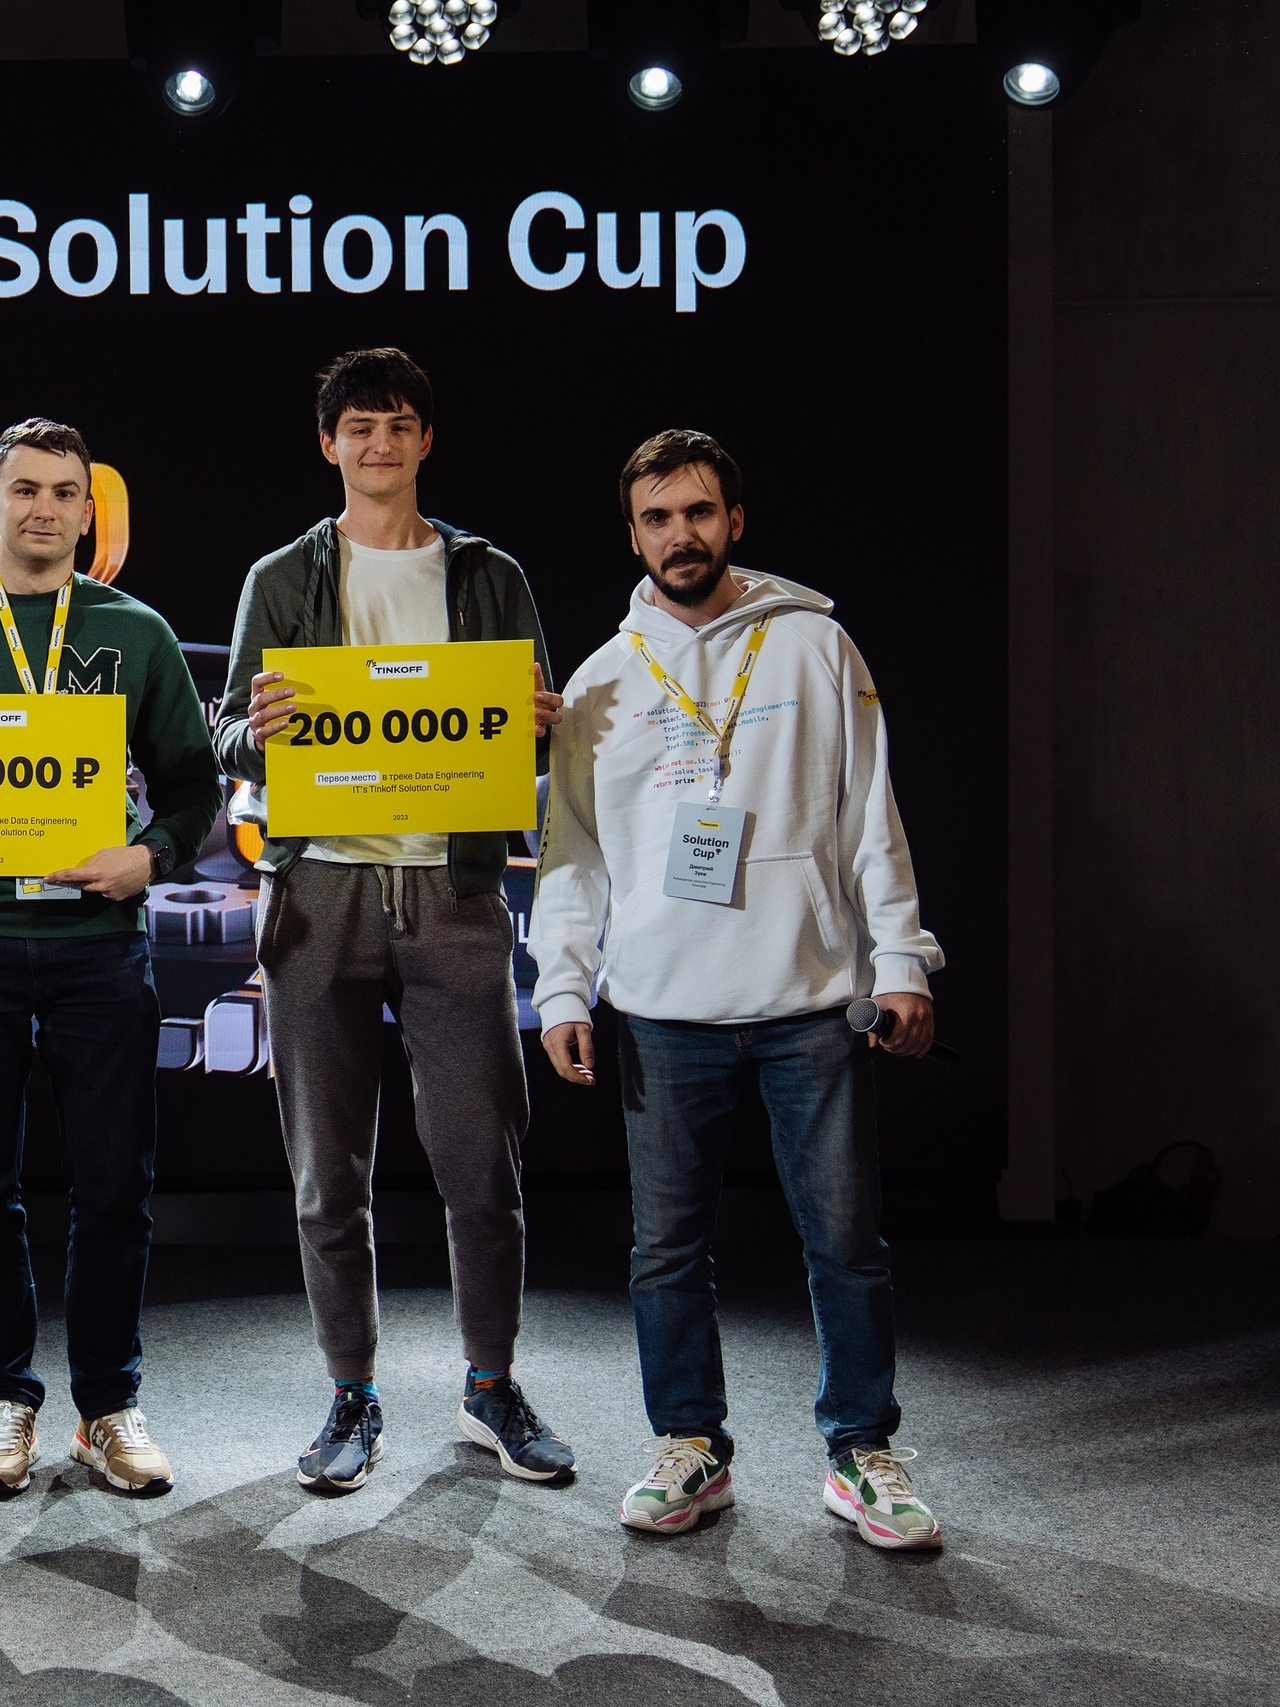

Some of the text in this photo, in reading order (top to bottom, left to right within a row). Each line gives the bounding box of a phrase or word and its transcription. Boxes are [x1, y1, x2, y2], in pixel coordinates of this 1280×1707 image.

[508, 191, 747, 312] Cup
[375, 665, 422, 675] TINKOFF
[288, 707, 509, 746] 200 000 ₽
[72, 757, 100, 789] ₽
[317, 774, 349, 784] Первое
[351, 774, 377, 782] место
[389, 772, 413, 782] треке
[415, 771, 434, 780] Data
[435, 770, 485, 782] Engineering
[352, 783, 450, 793] IT's Tinkoff Solution Cup
[653, 777, 696, 789] return prize
[11, 817, 29, 825] Data
[30, 817, 77, 827] Engineering
[29, 828, 45, 838] Cup
[682, 834, 730, 848] Solution
[693, 848, 715, 861] Cup
